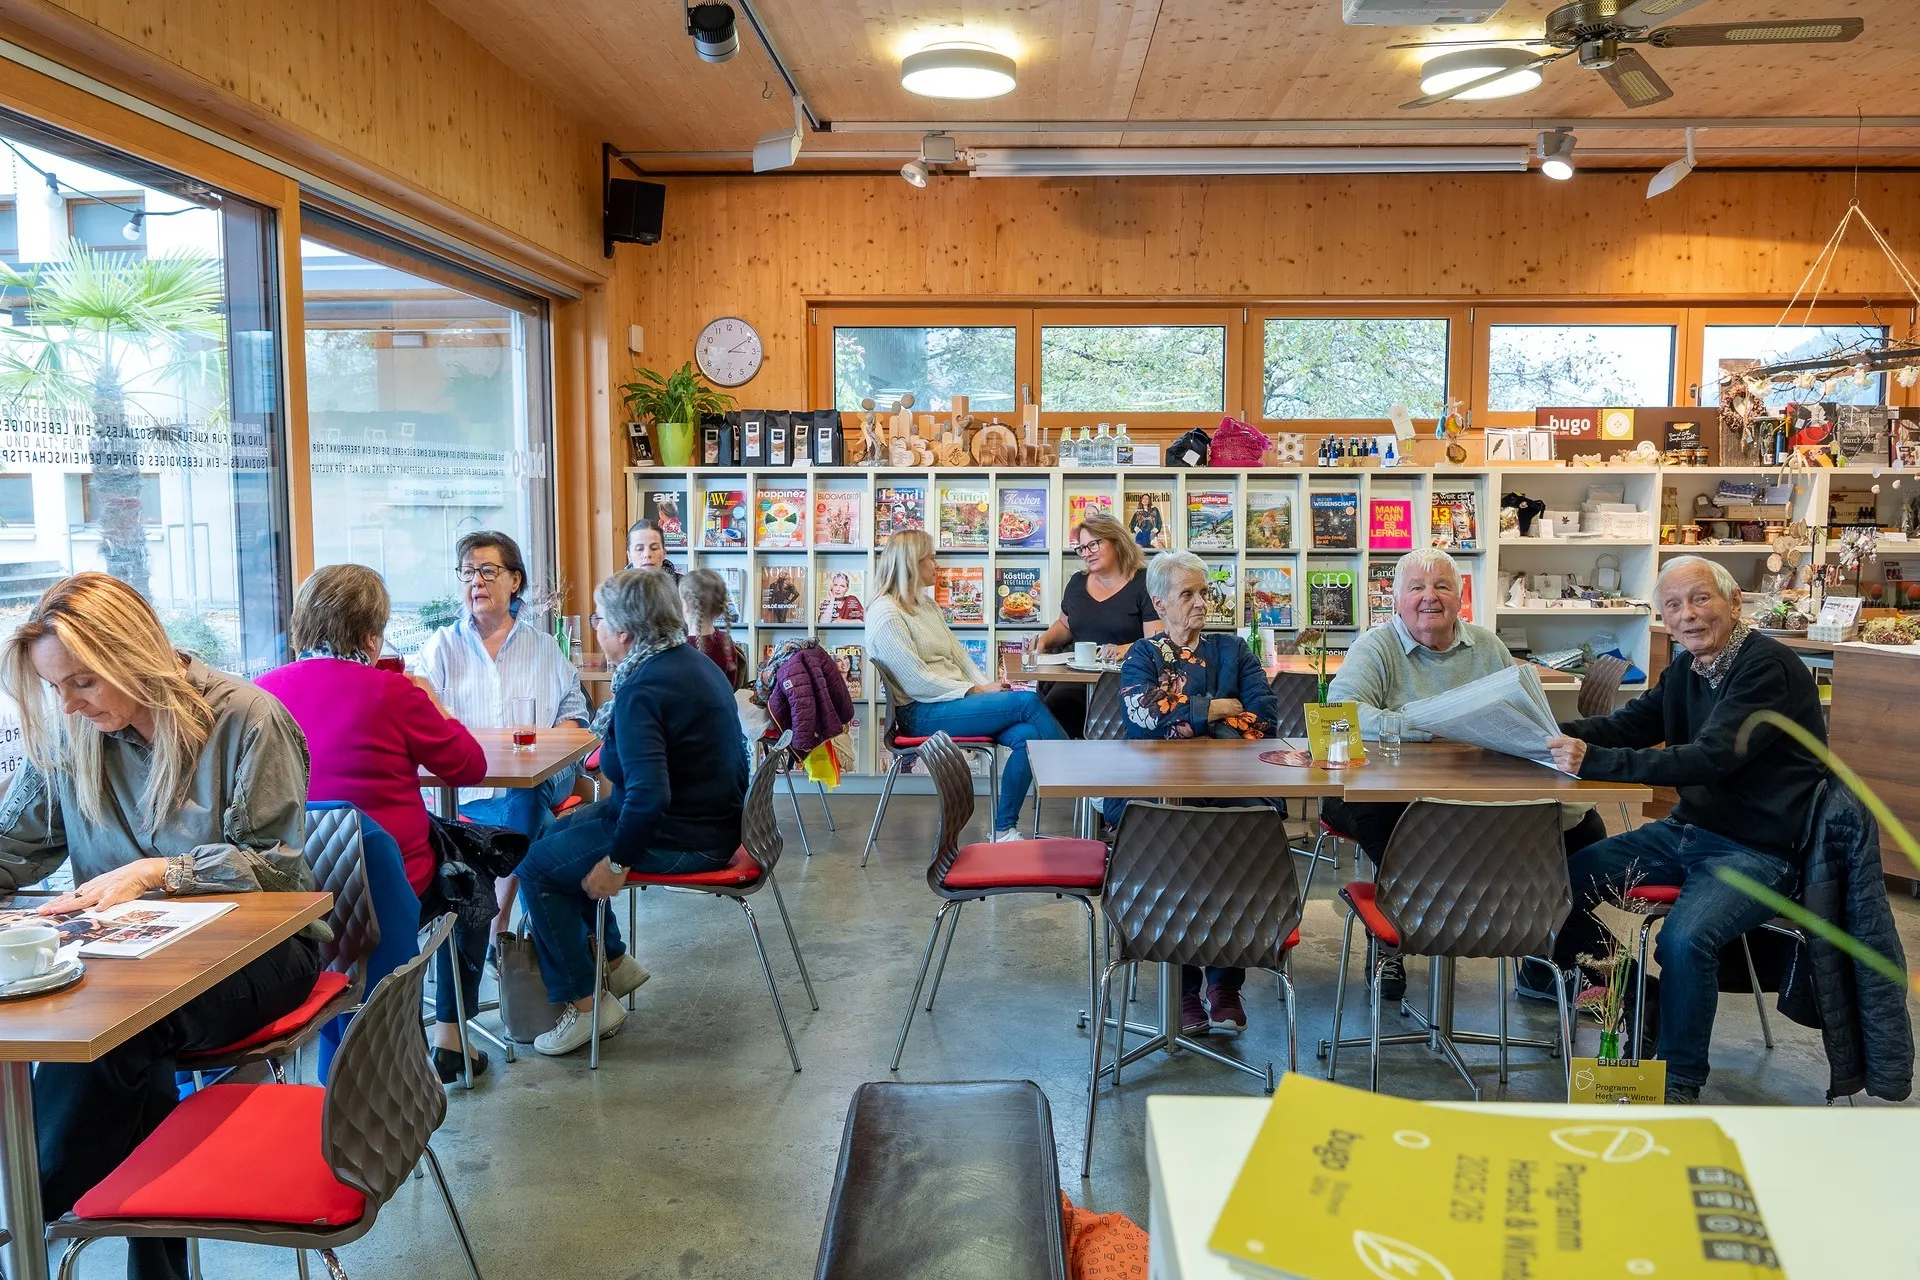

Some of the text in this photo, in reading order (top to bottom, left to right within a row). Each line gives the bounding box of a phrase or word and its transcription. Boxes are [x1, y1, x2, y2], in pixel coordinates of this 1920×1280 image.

[1549, 415, 1591, 436] bugo
[652, 490, 680, 503] art
[757, 489, 806, 499] happinez
[946, 488, 988, 502] Garten
[1004, 493, 1042, 505] Kochen
[1190, 495, 1228, 504] Bergsteiger
[1375, 505, 1404, 514] MANN
[1432, 507, 1450, 521] 13
[1376, 513, 1404, 522] KANN
[1384, 521, 1397, 530] ES
[1370, 529, 1410, 538] LERNEN.
[1003, 572, 1035, 580] köstlich
[1311, 572, 1352, 589] GEO
[1595, 1083, 1637, 1093] Programm
[1631, 1093, 1657, 1102] Winter
[1310, 1127, 1366, 1173] bugo
[1505, 1158, 1540, 1214] Herbst
[1544, 1161, 1587, 1253] Programm
